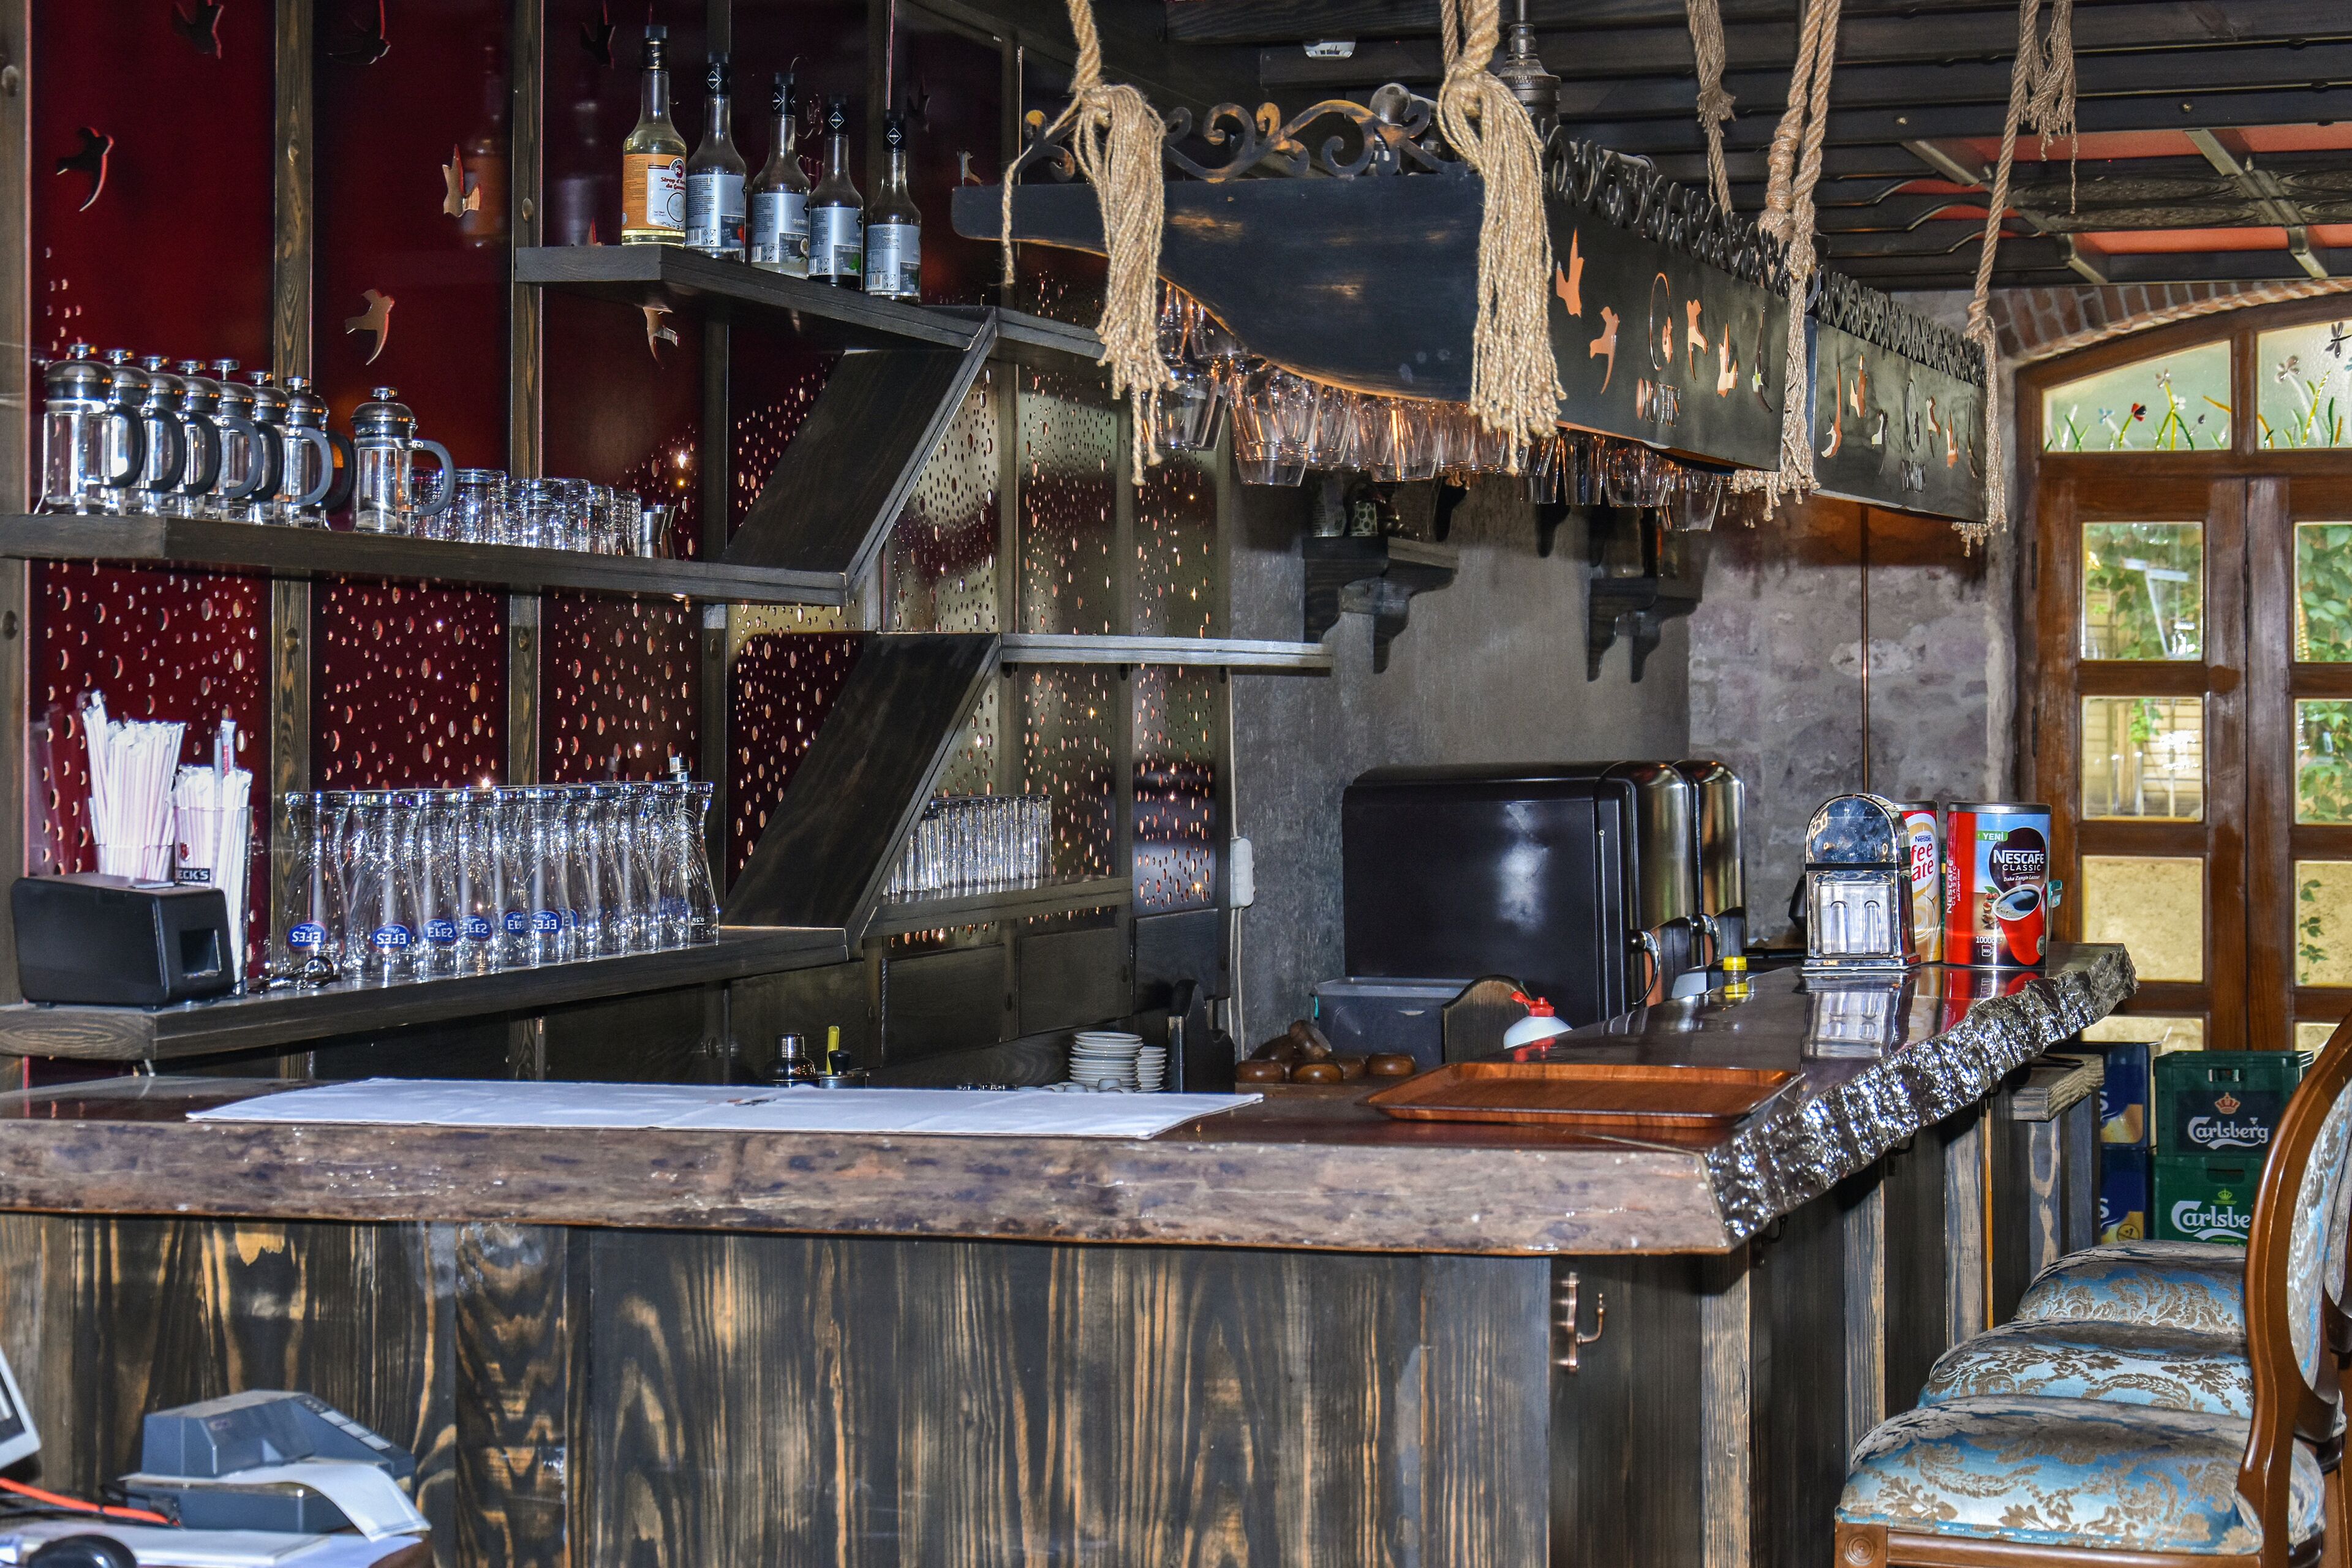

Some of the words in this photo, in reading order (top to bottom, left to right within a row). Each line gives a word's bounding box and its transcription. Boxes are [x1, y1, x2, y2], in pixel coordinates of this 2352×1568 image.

[1983, 832, 2003, 840] YENİ
[176, 869, 209, 880] ECK'S
[292, 931, 322, 943] EFES
[376, 933, 407, 944] EFES
[2187, 1117, 2269, 1145] Carlsberg
